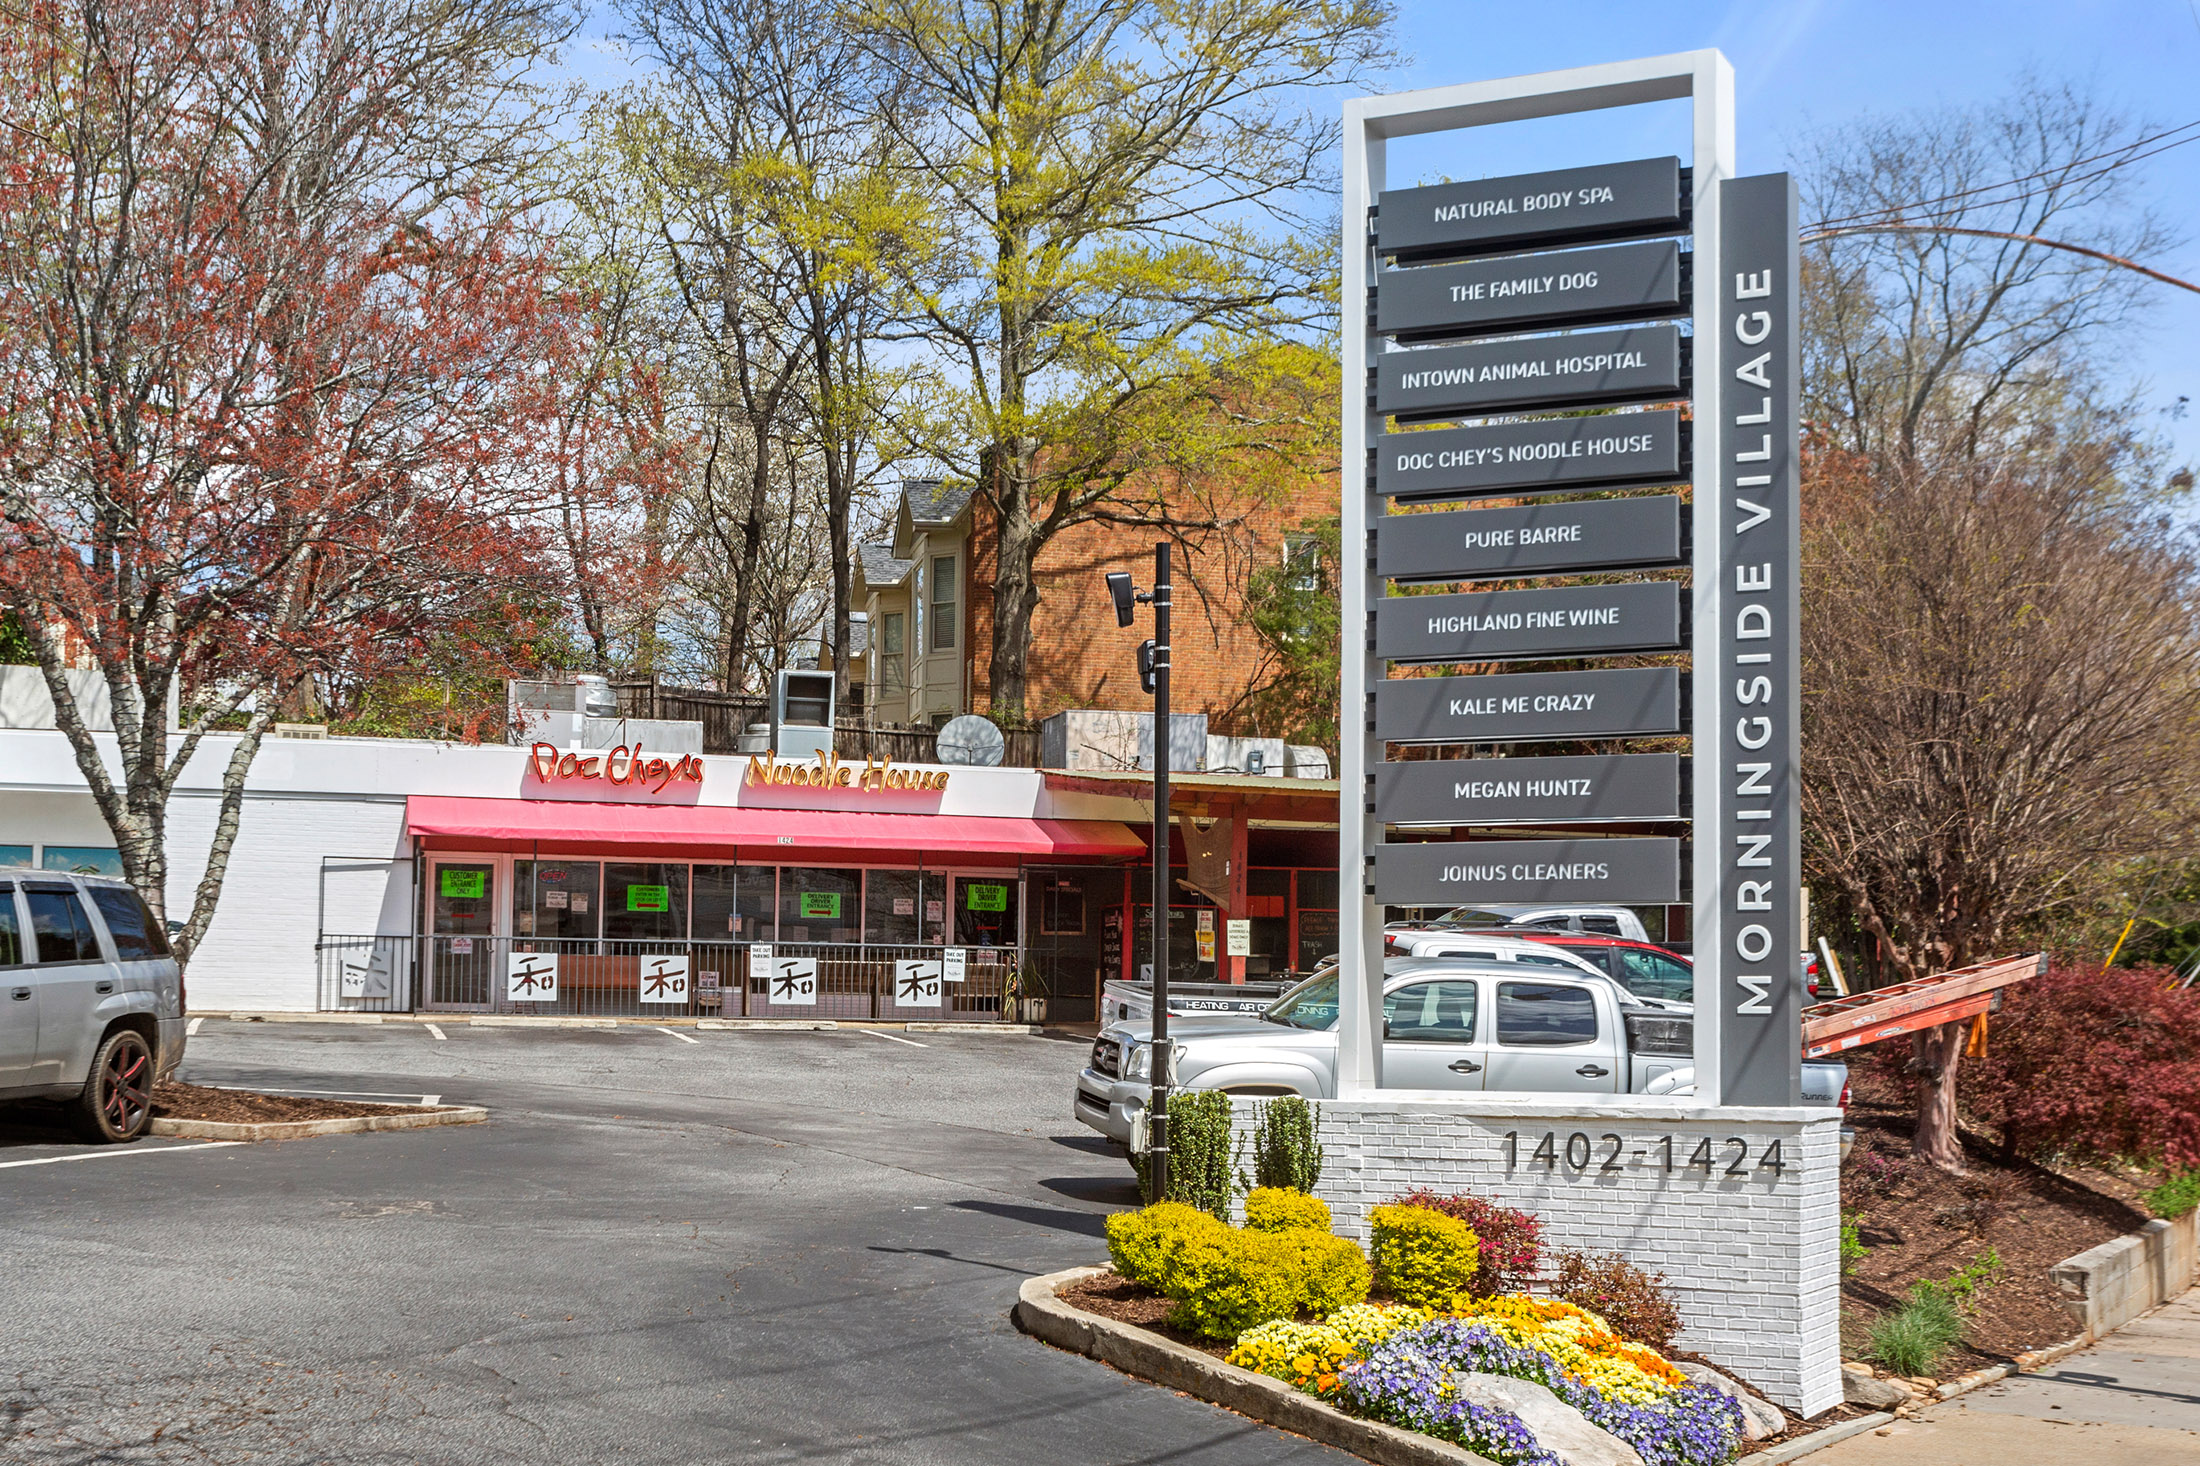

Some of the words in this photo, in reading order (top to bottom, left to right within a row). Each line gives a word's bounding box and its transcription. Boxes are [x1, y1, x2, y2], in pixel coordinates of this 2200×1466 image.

[1434, 198, 1519, 223] NATURAL
[1523, 190, 1573, 212] BODY
[1578, 186, 1614, 205] SPA
[1450, 284, 1485, 303] THE
[1489, 275, 1554, 299] FAMILY
[1559, 271, 1598, 291] DOG
[1402, 370, 1475, 390] INTOWN
[1479, 361, 1551, 383] ANIMAL
[1555, 351, 1647, 375] HOSPITAL
[1735, 268, 1773, 535] VILLAGE
[1397, 452, 1435, 472] DOC
[1438, 446, 1504, 468] CHEY'S
[1508, 440, 1583, 463] NOODLE
[1588, 434, 1653, 456] HOUSE
[1465, 529, 1515, 549] PURE
[1519, 524, 1582, 545] BARRE
[1428, 612, 1522, 634] HIGHLAND
[1526, 610, 1566, 629] FINE
[1568, 607, 1620, 627] WINE
[1449, 698, 1497, 716] KALE
[1501, 696, 1529, 714] ME
[1533, 693, 1596, 713] CRAZY
[607, 742, 704, 795] Chey's
[746, 748, 852, 791] Noodle
[859, 752, 951, 794] House
[1454, 781, 1521, 799] MEGAN
[1526, 778, 1592, 797] HUNTZ
[1735, 562, 1773, 1014] MORNINGSIDE
[778, 836, 795, 845] 1424
[449, 871, 479, 880] CUSTOMER
[450, 880, 477, 888] ENTRANCE
[538, 870, 568, 881] OPEN
[1438, 864, 1507, 882] JOINUS
[1511, 862, 1609, 881] CLEANERS
[975, 886, 1001, 894] DELIVERY
[512, 956, 554, 996] 和
[643, 959, 686, 1000] 和
[772, 961, 814, 1000] 和
[899, 963, 939, 1002] 和
[1185, 1000, 1229, 1011] HEATING
[1239, 1002, 1256, 1012] AIR
[1505, 1130, 1787, 1178] 1402-1424
